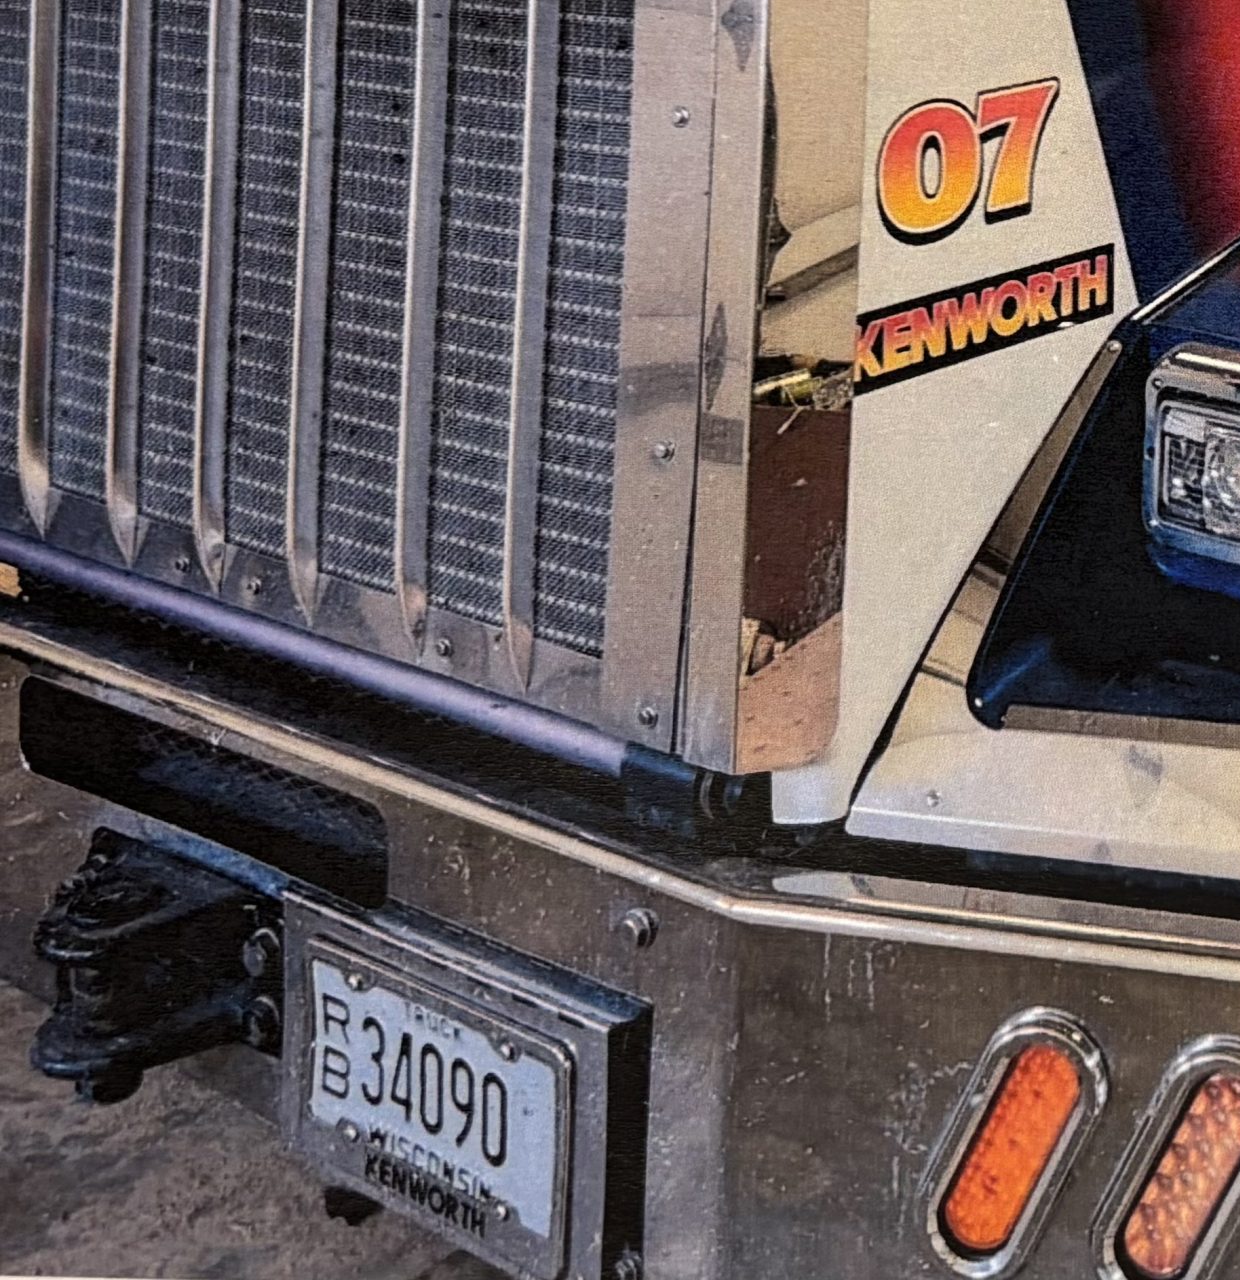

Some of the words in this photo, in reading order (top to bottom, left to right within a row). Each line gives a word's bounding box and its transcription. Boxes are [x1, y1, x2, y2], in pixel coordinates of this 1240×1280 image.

[876, 76, 1060, 246] 07
[853, 254, 1108, 382] KENWORTH
[362, 1016, 508, 1167] 34090
[364, 1149, 487, 1239] KENWORTH
[369, 1124, 494, 1202] WISCONSIN
